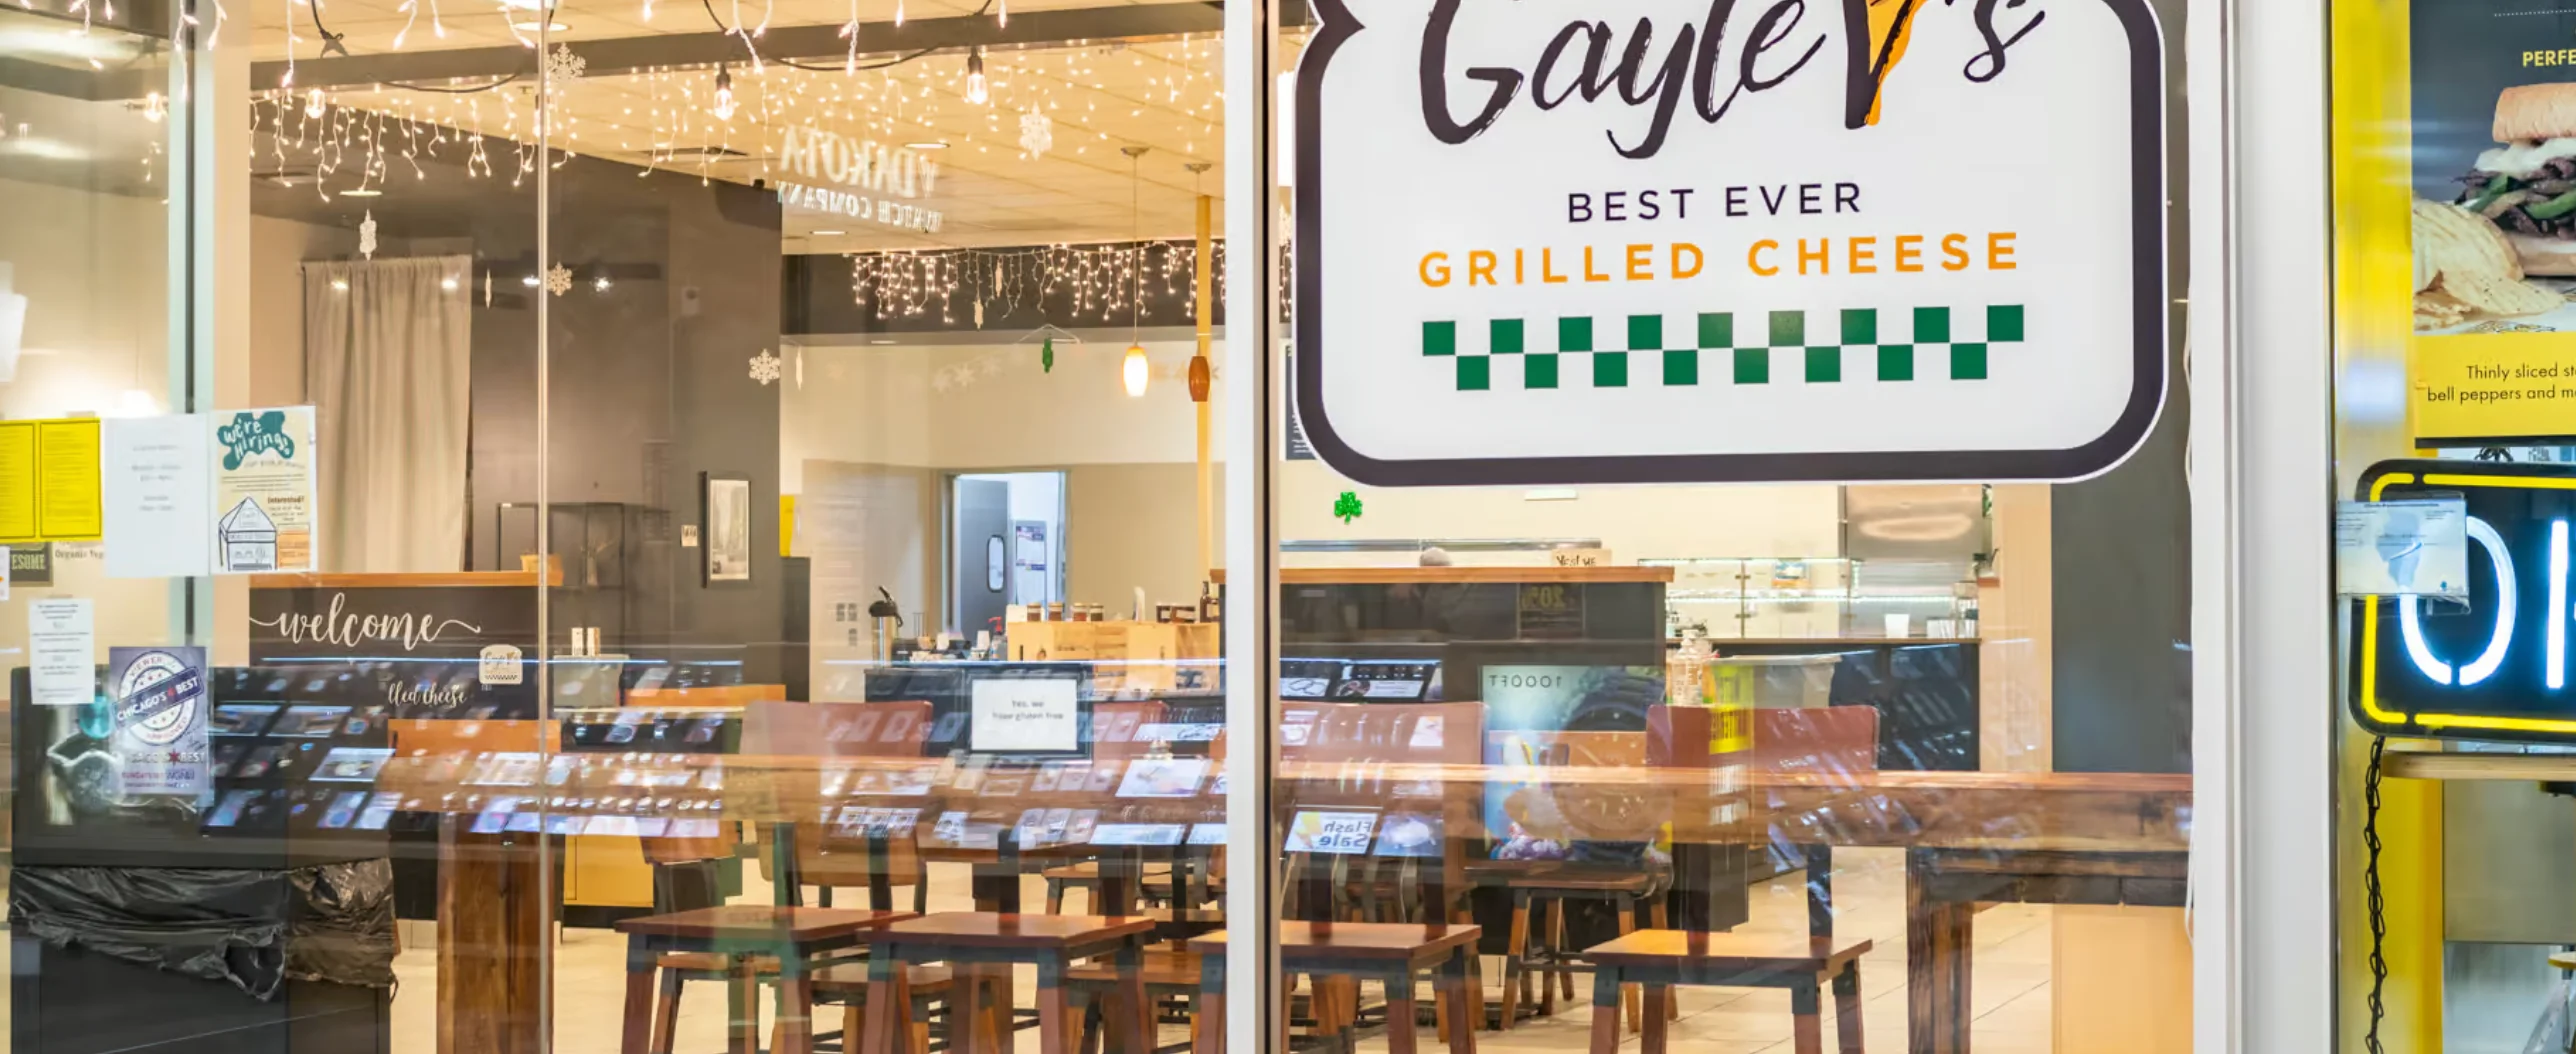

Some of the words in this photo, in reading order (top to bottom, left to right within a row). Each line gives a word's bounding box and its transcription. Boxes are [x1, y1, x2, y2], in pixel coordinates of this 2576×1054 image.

[2522, 48, 2576, 67] PERFE
[1568, 188, 1694, 223] BEST
[1726, 182, 1860, 217] EVER
[1418, 242, 1704, 288] GRILLED
[1747, 231, 2017, 277] CHEESE
[2466, 363, 2510, 382] Thinly
[2515, 361, 2558, 378] sliced
[2427, 385, 2454, 401] bell
[2460, 389, 2521, 405] peppers
[2526, 384, 2555, 399] and
[249, 592, 482, 651] welcome
